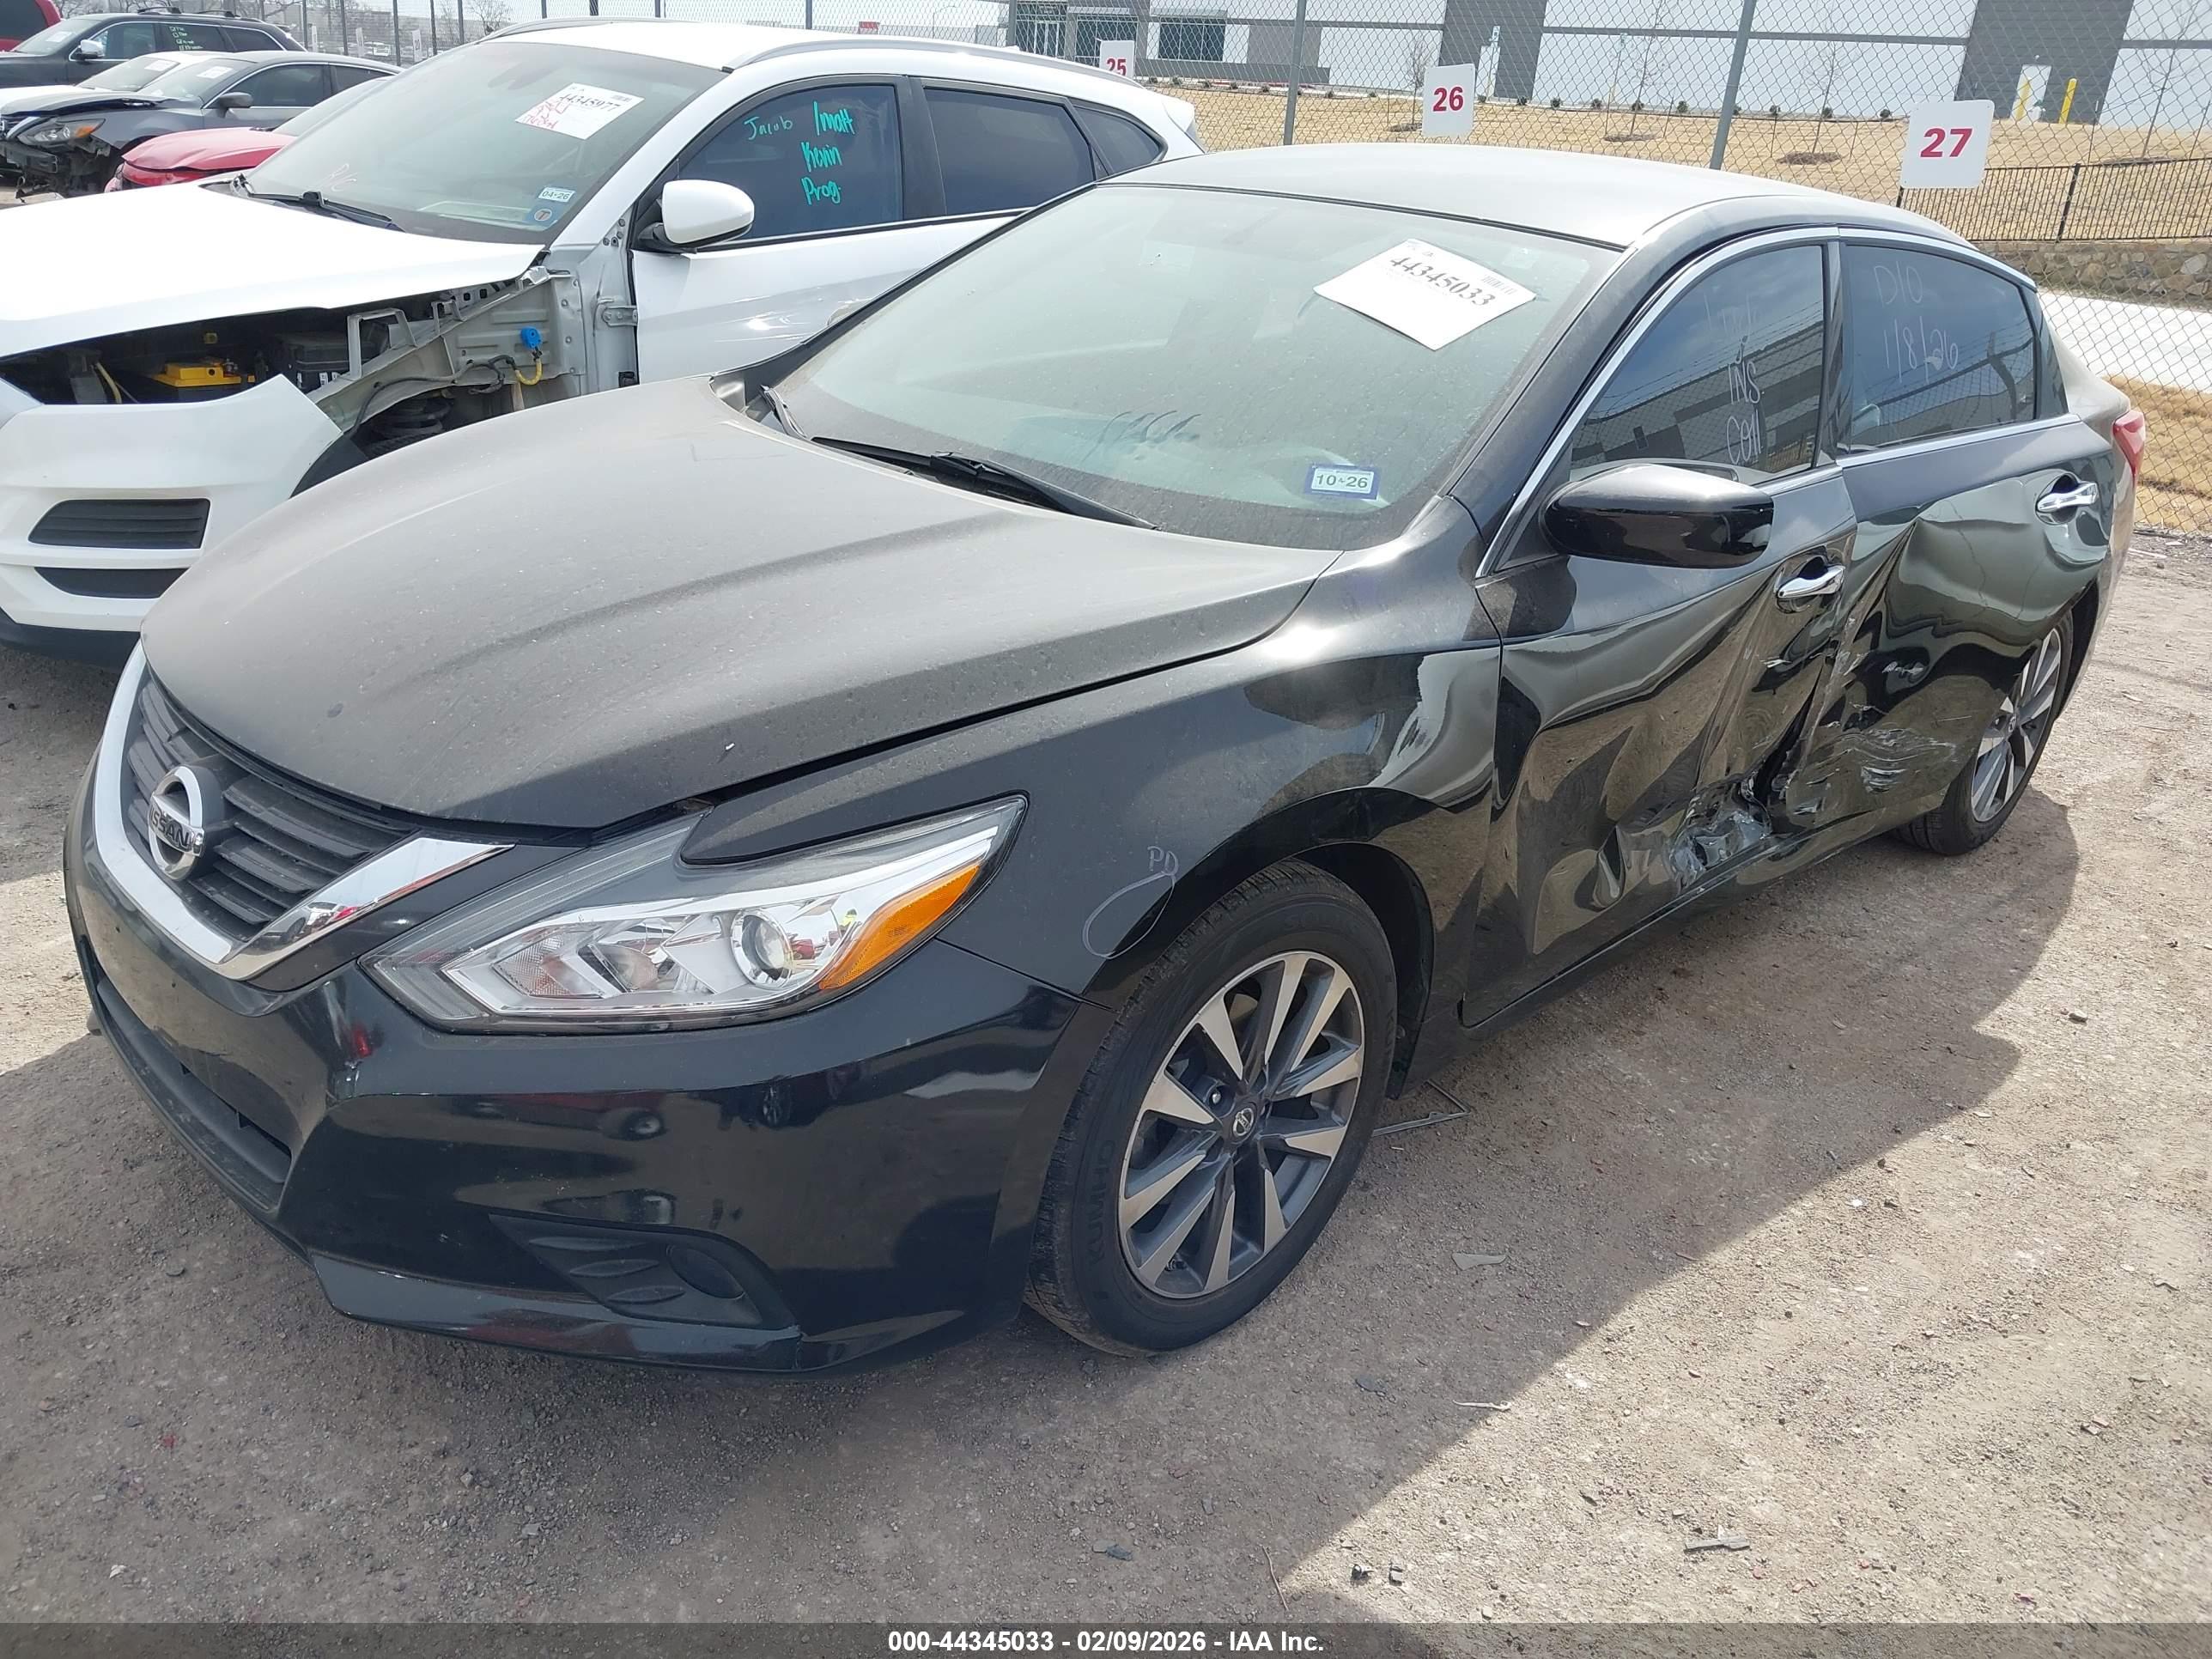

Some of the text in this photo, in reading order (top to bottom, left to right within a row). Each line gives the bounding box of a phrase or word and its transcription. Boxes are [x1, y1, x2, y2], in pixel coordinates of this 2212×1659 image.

[1106, 58, 1127, 76] 25
[1431, 86, 1465, 112] 26
[800, 142, 842, 173] Kevin
[1919, 127, 1973, 158] 27
[1390, 257, 1497, 307] 44345033
